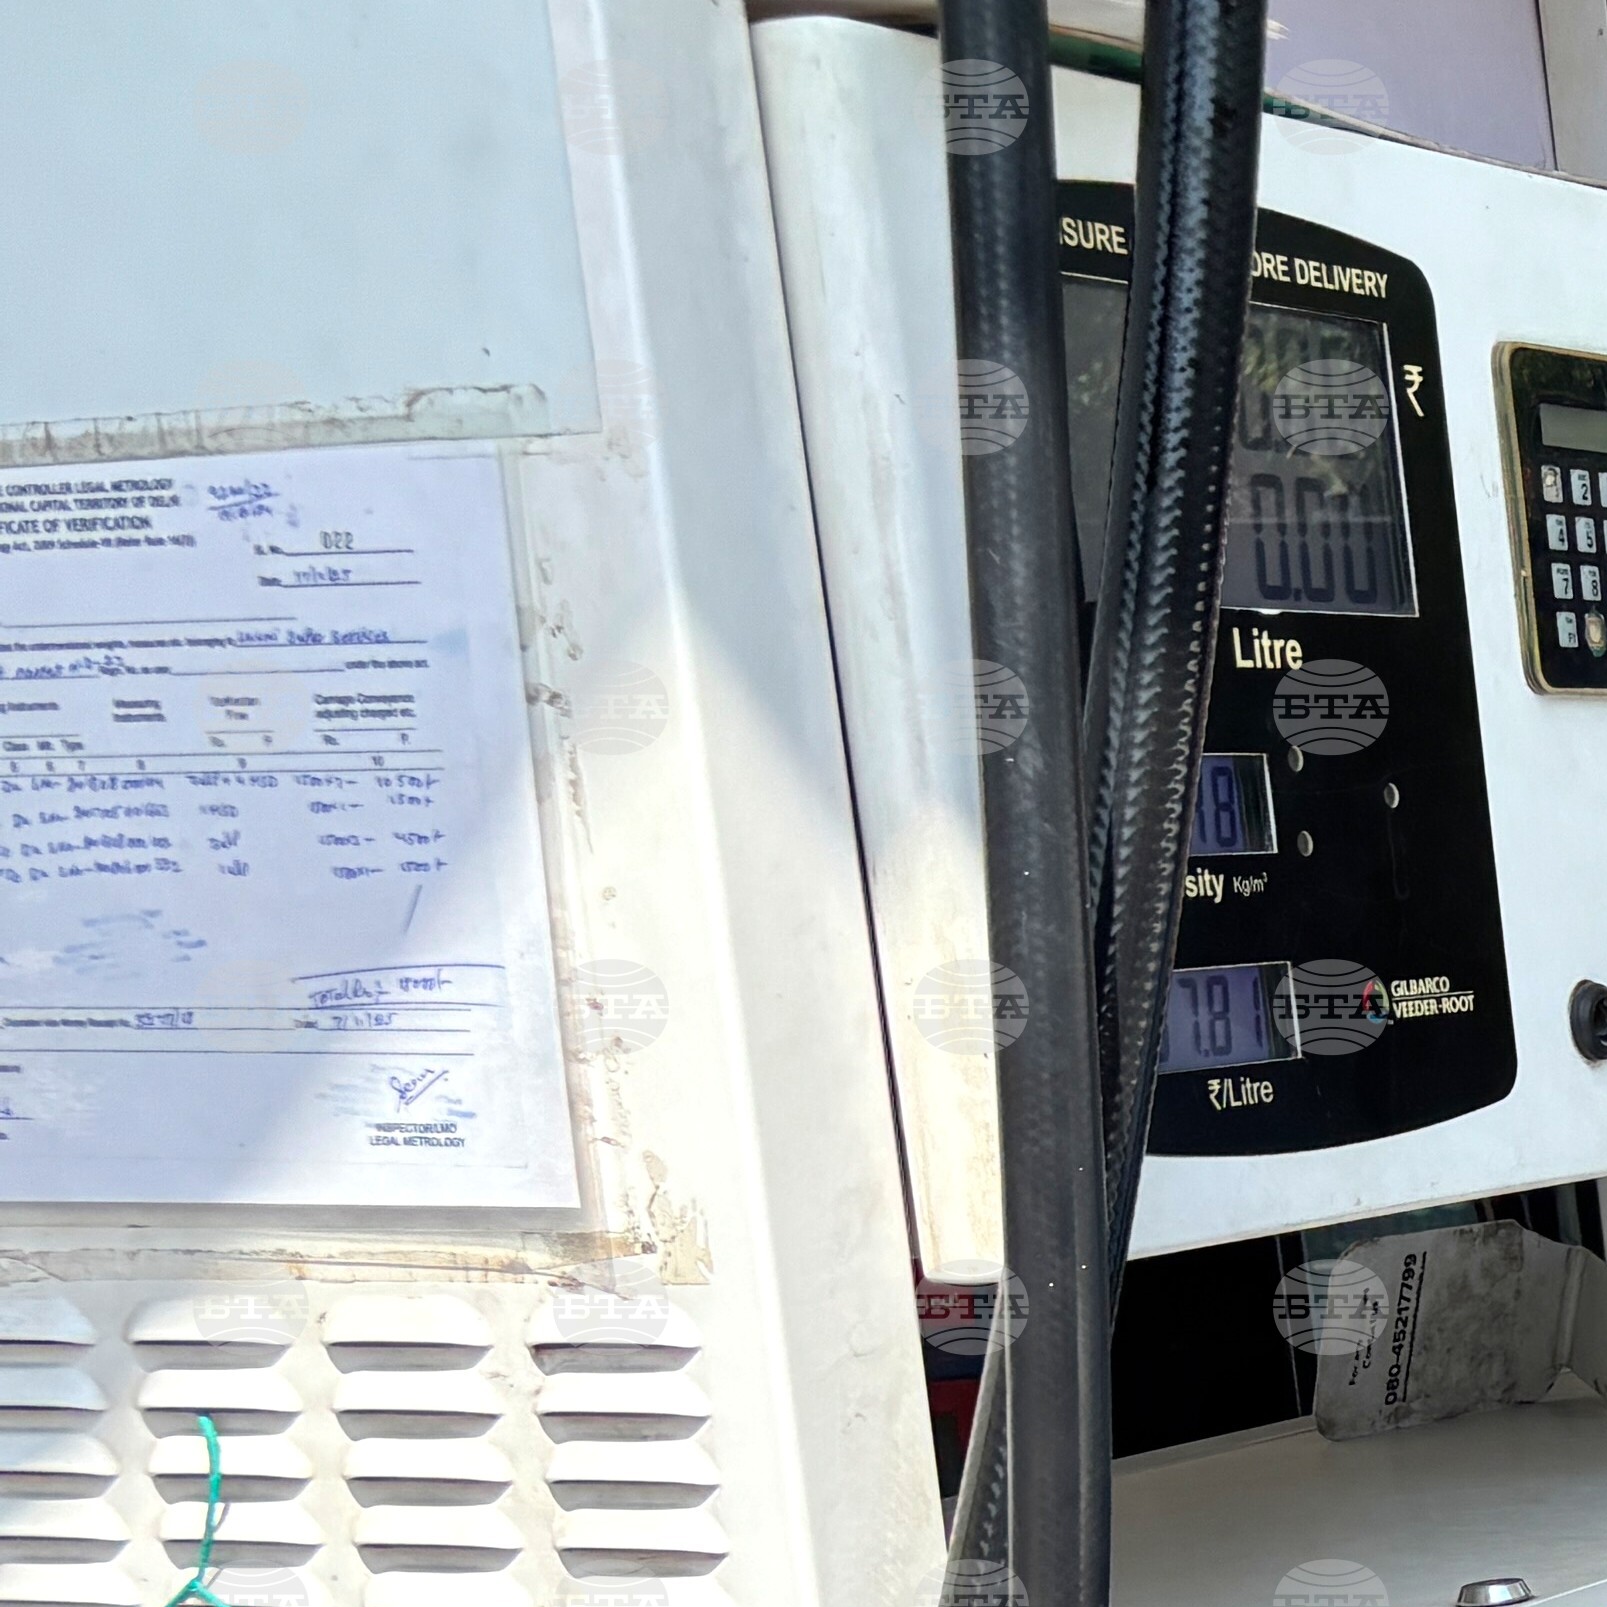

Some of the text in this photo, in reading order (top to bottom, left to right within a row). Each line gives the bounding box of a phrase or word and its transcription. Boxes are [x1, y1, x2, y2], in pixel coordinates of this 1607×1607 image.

[1293, 257, 1389, 298] DELIVERY
[42, 519, 60, 533] OF
[64, 515, 153, 532] VERIFICATION
[1233, 627, 1303, 670] Litre
[1391, 976, 1450, 996] GILBARCO
[1393, 994, 1475, 1018] VEEDER-ROOT
